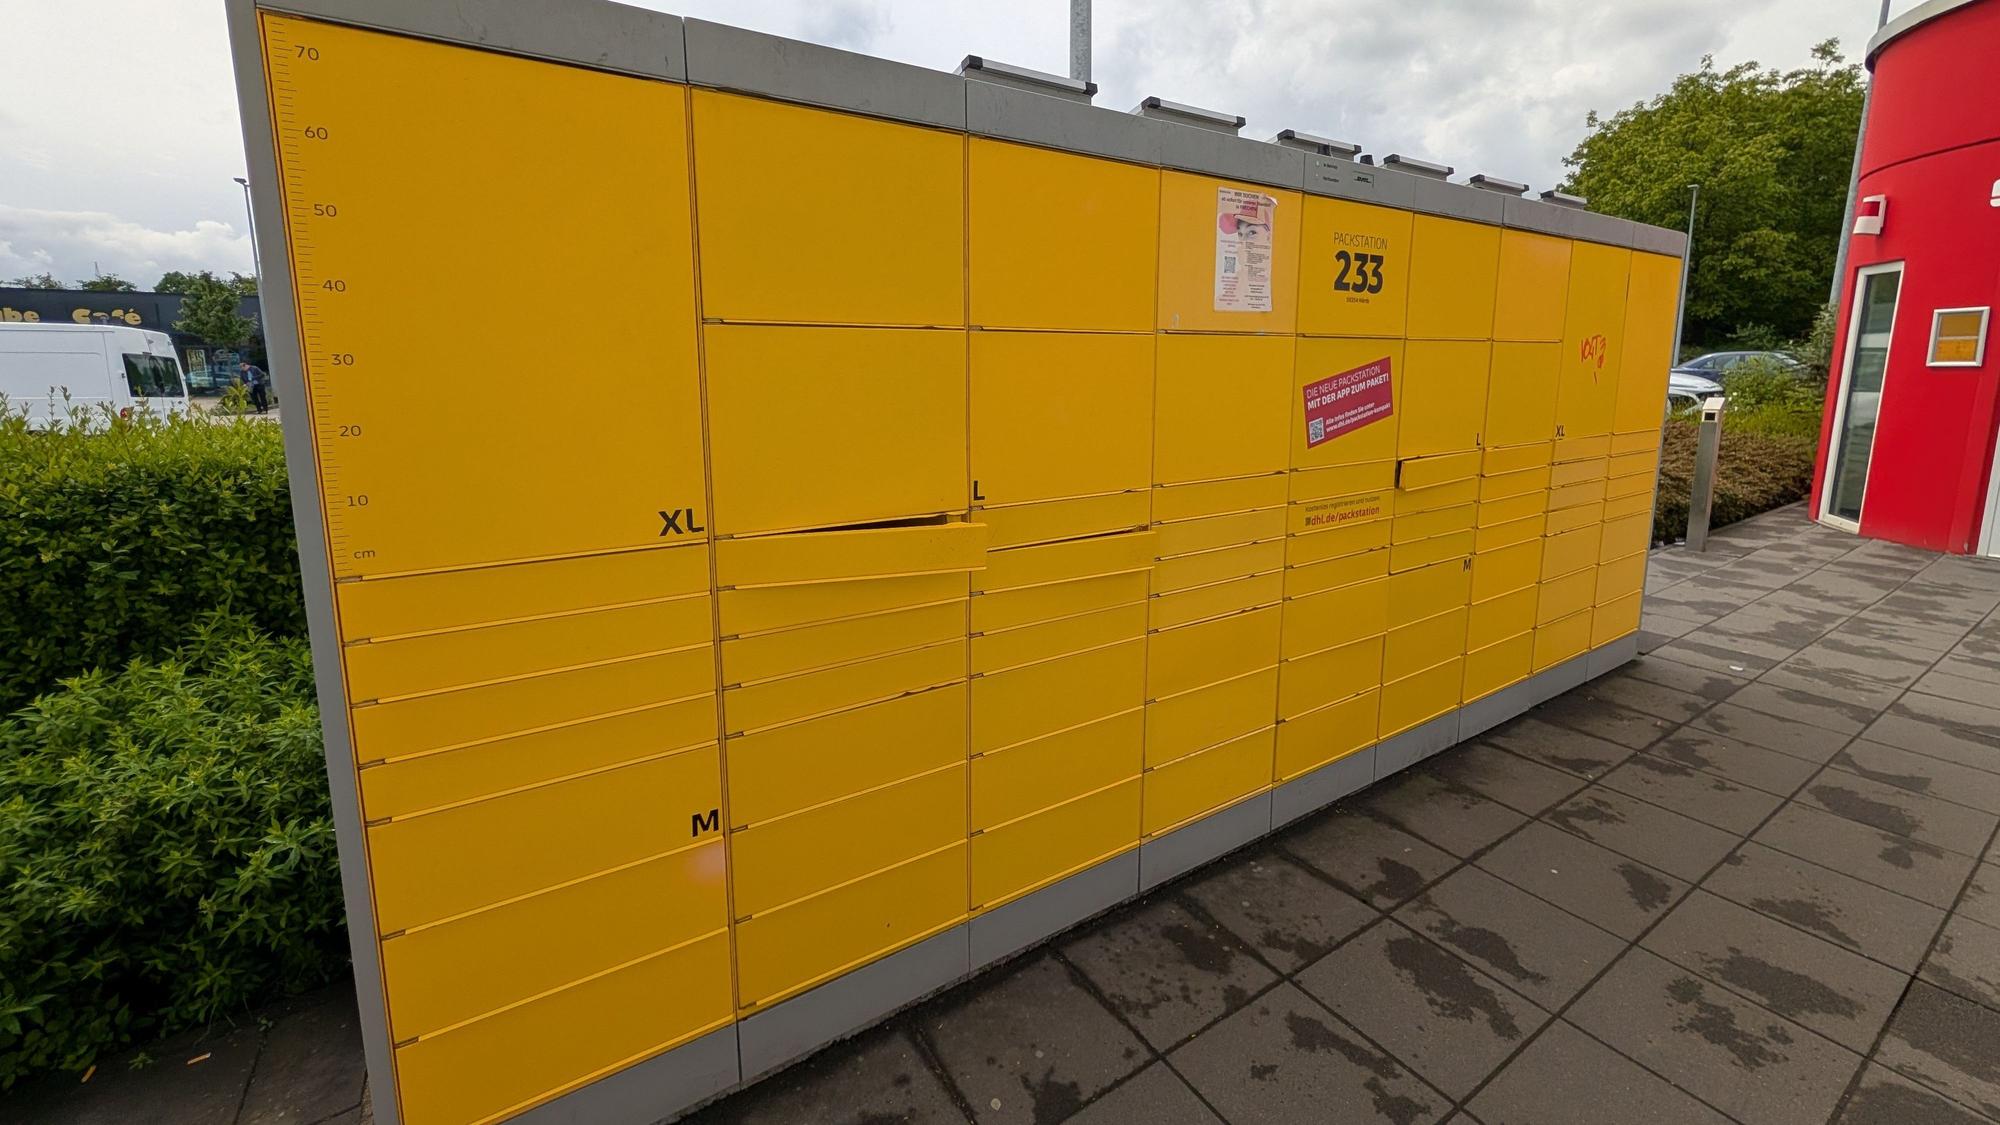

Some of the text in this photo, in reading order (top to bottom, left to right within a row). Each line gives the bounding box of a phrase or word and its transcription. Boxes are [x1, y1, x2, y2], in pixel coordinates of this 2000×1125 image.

[294, 45, 320, 61] 70
[304, 126, 328, 140] 60
[313, 204, 337, 218] 50
[1334, 232, 1388, 250] PACKSTATION
[1334, 250, 1384, 294] 233
[322, 280, 346, 292] 40
[331, 354, 354, 366] 30
[1306, 366, 1380, 399] DIE NEUE PACKSTATION
[1308, 372, 1389, 411] MIT DER APP ZUM PAKET!
[339, 426, 362, 437] 20
[1556, 425, 1565, 438] XL
[1476, 433, 1481, 446] L
[973, 480, 985, 501] L
[347, 494, 368, 506] 10
[658, 508, 705, 537] XL
[1312, 506, 1380, 525] dhl.de/packstation
[354, 549, 376, 560] cm
[1463, 558, 1471, 572] M
[692, 809, 719, 837] M
